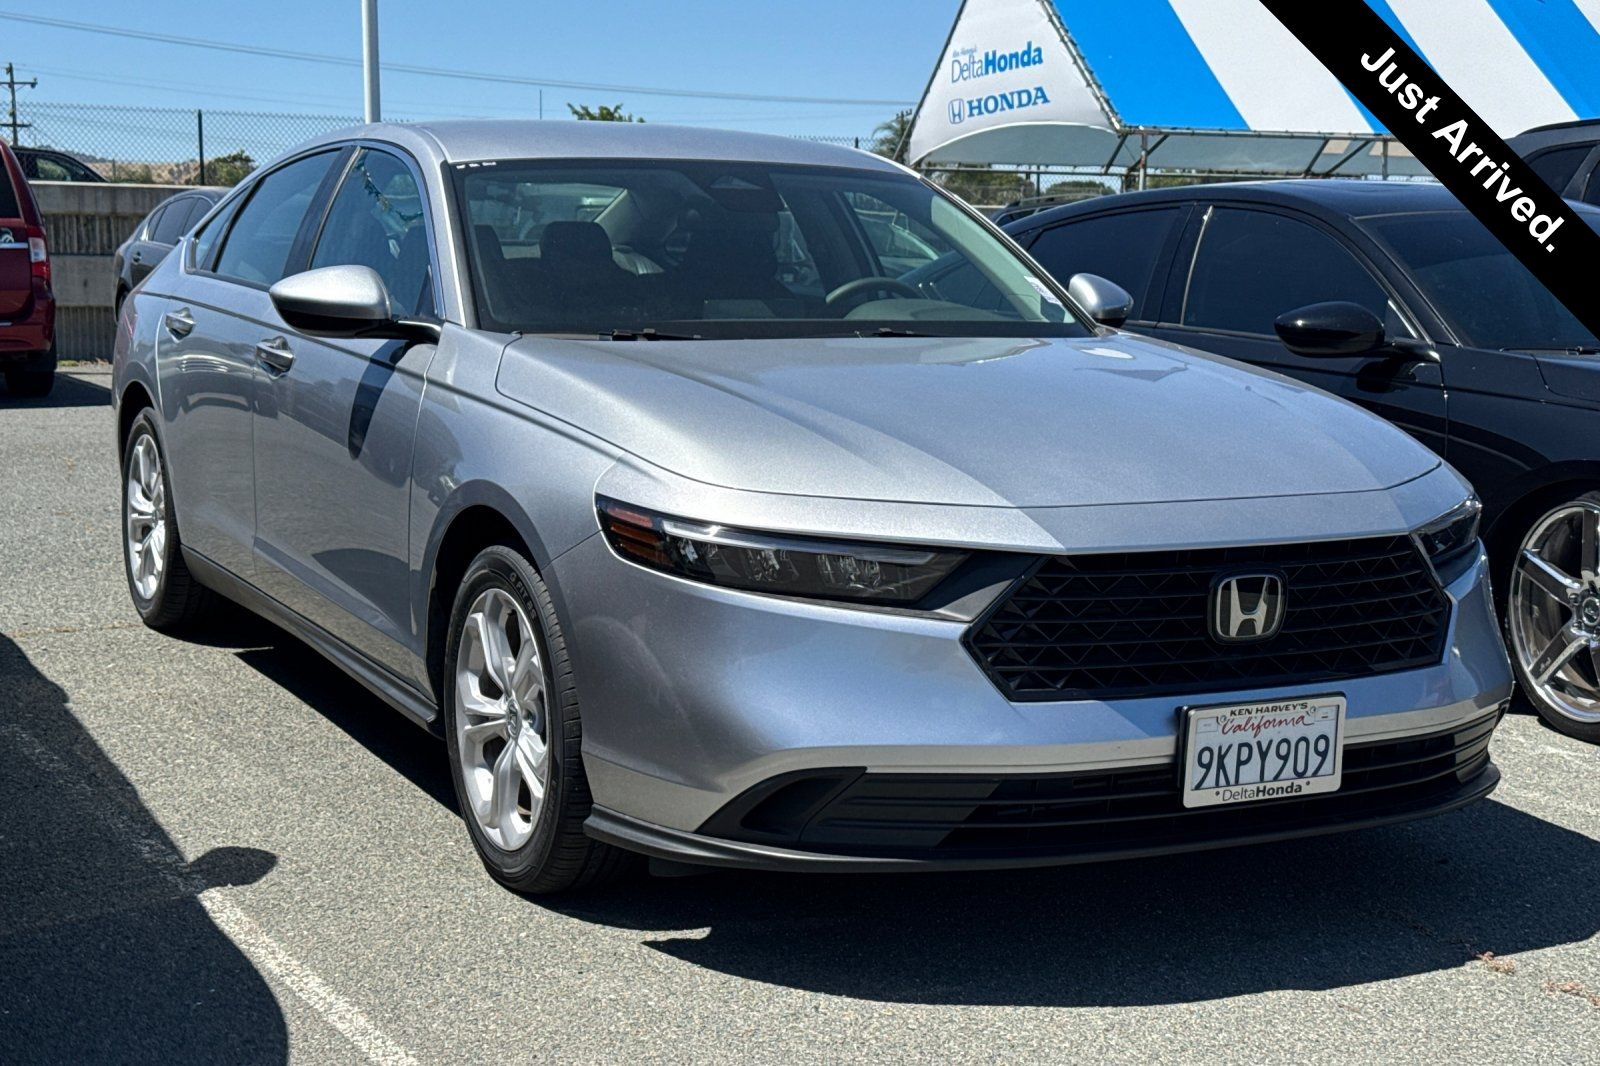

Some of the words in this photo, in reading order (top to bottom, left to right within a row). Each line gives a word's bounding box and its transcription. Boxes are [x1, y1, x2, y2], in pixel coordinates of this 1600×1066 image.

[951, 40, 1043, 83] DeltaHonda
[966, 86, 1050, 118] HONDA
[1229, 707, 1253, 717] KEN
[1255, 702, 1309, 714] HARVEY'S
[1221, 714, 1315, 738] California
[1194, 734, 1331, 790] 9KPY909
[1222, 782, 1302, 801] DeltaHonda
